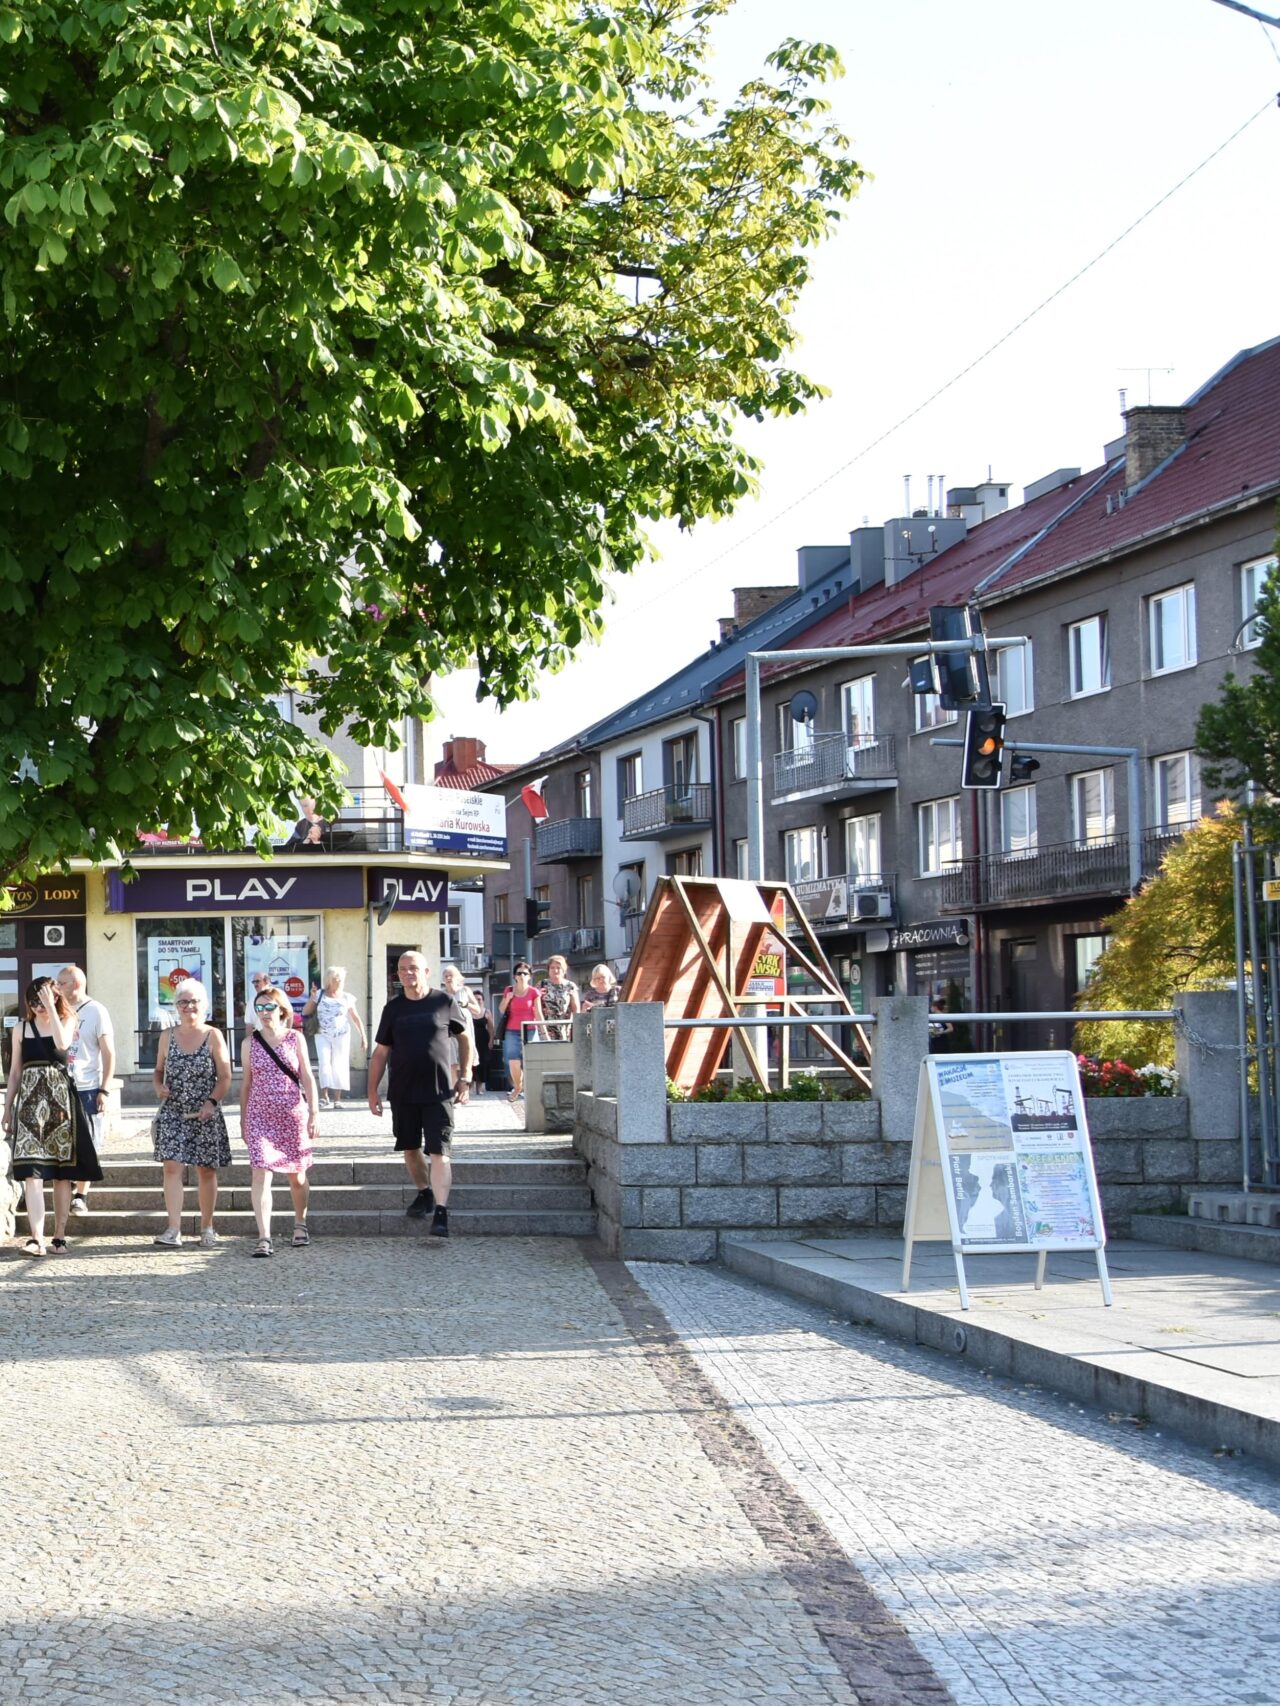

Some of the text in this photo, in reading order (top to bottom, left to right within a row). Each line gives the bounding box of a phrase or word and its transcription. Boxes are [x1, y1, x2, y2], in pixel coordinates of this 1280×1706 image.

[455, 818, 491, 833] Kurowska
[44, 889, 80, 900] LODY
[186, 877, 297, 901] PLAY
[899, 925, 958, 944] PRACOWNIA
[952, 1156, 961, 1175] Piotr
